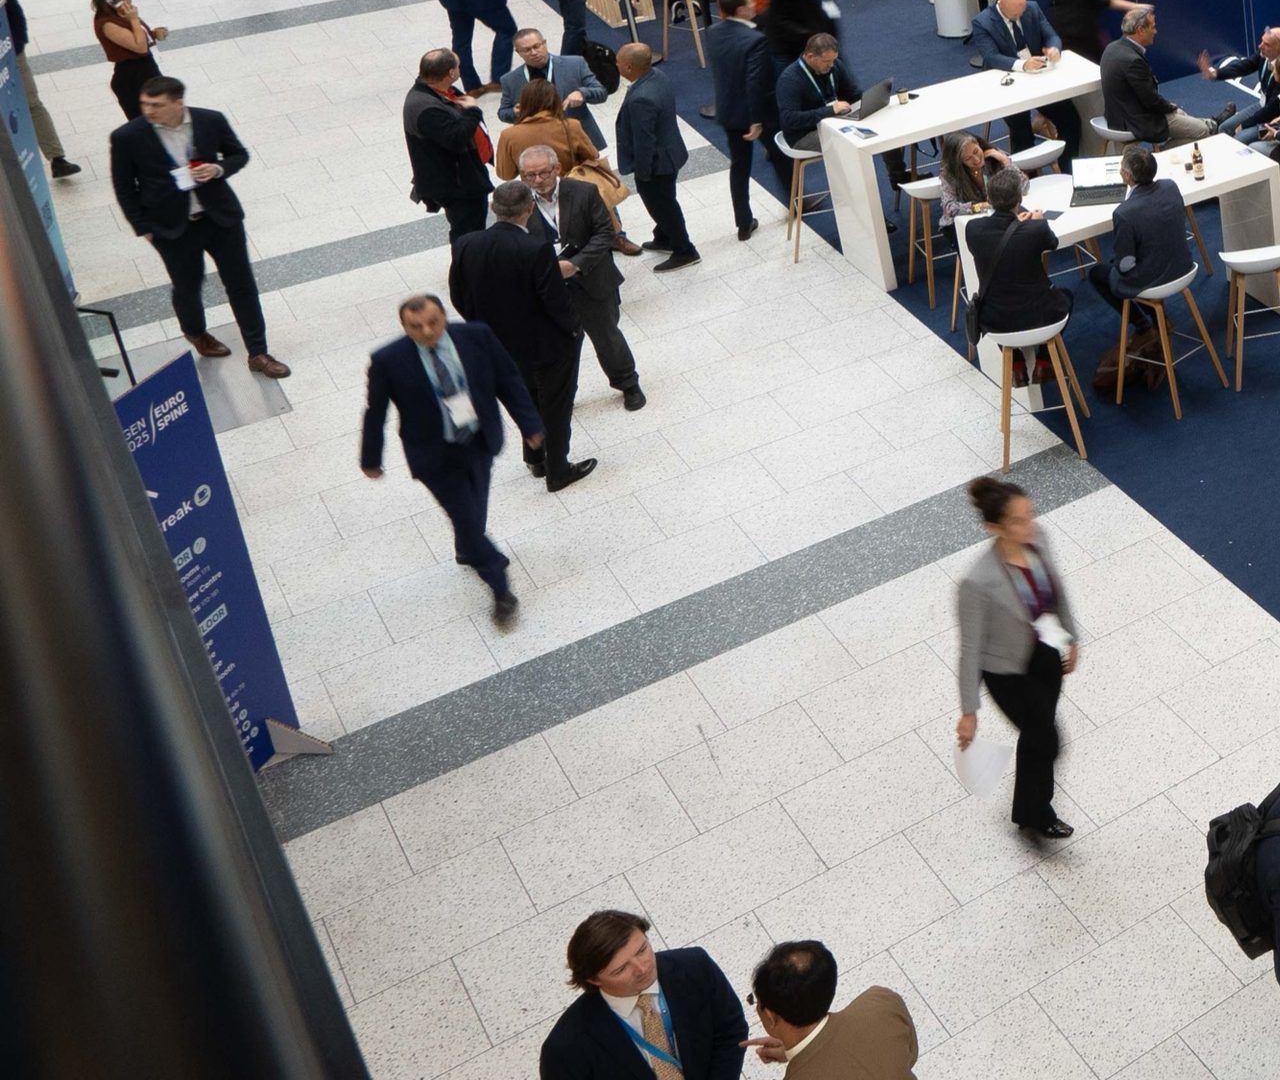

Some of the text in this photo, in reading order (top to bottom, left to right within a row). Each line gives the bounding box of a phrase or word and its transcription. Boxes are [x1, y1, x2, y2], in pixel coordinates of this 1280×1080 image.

[154, 391, 185, 419] EURO
[157, 402, 189, 431] SPINE
[128, 431, 150, 452] 025
[160, 500, 193, 532] reak
[201, 607, 226, 634] LOOR
